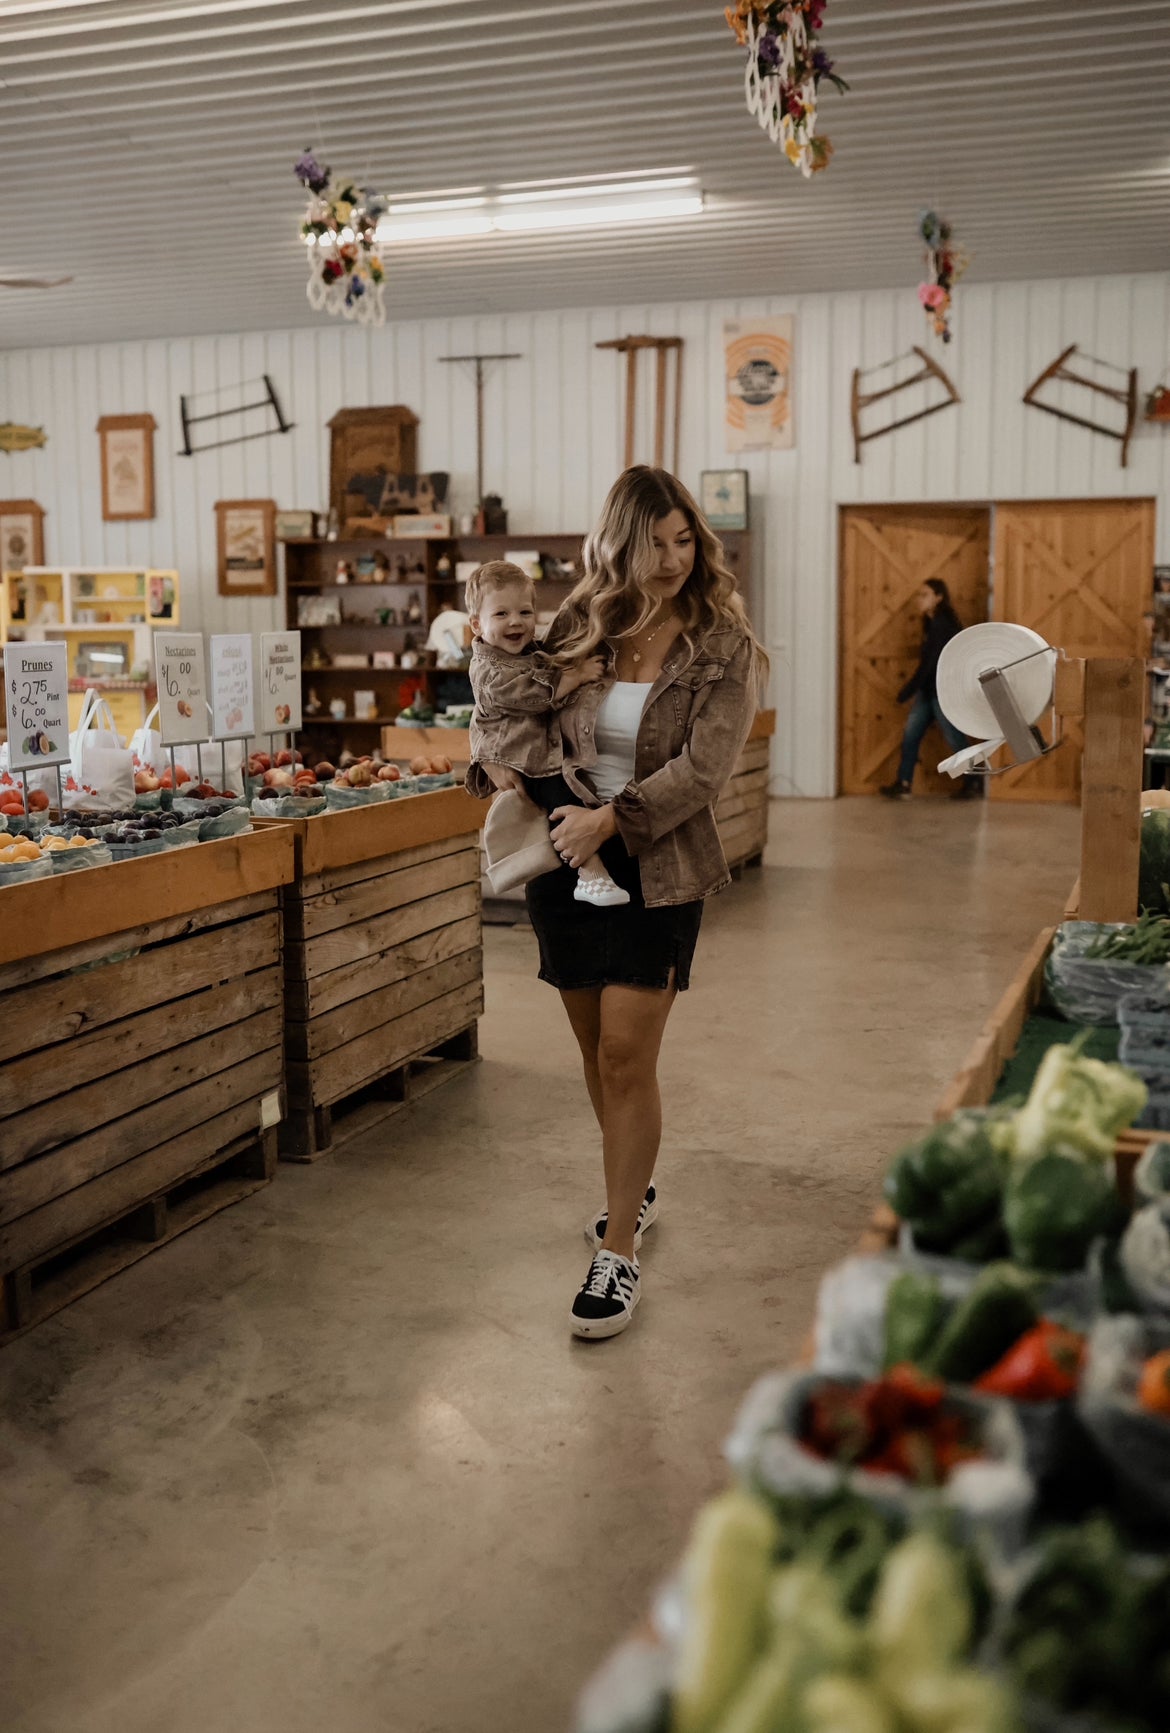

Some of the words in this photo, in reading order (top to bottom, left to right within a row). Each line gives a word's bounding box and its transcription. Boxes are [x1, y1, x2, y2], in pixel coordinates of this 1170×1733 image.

[165, 646, 197, 657] Nectarines
[21, 659, 53, 672] Prunes
[46, 693, 60, 701] Pint
[43, 718, 61, 729] Quart
